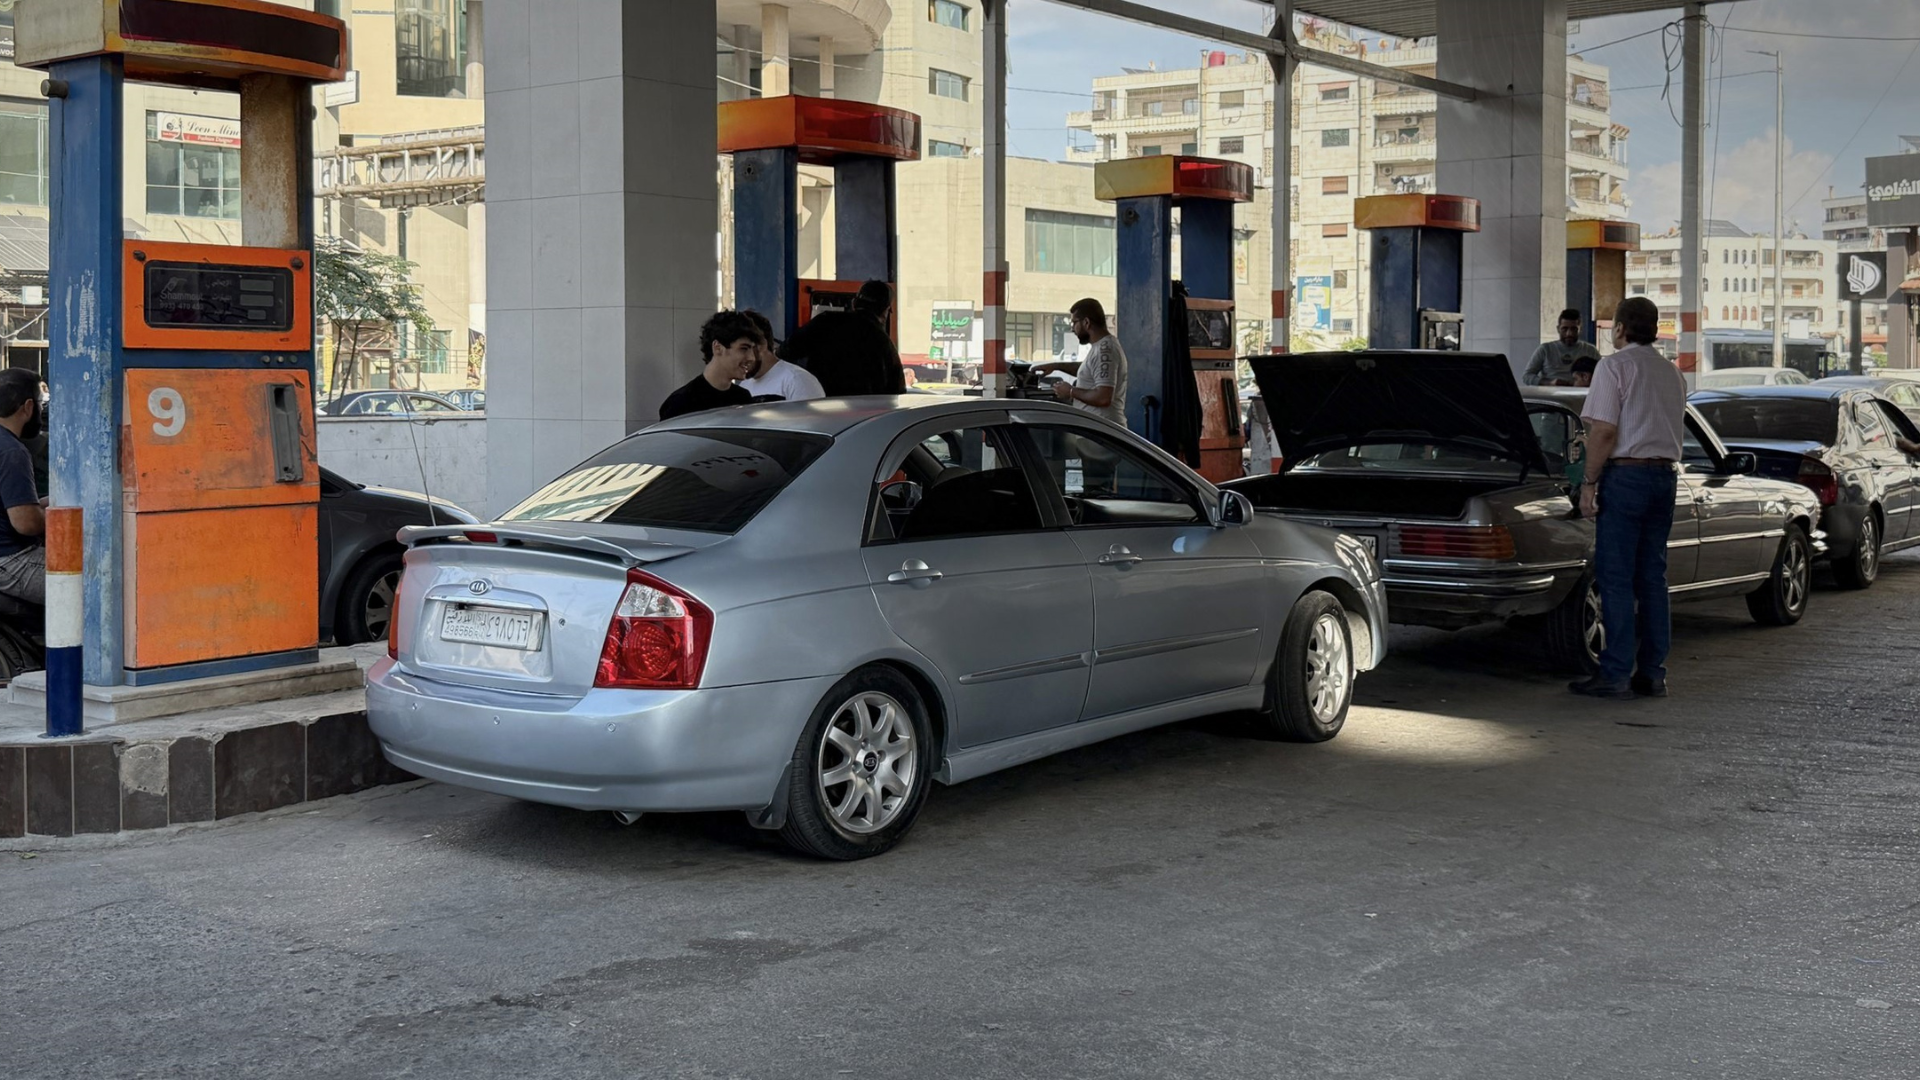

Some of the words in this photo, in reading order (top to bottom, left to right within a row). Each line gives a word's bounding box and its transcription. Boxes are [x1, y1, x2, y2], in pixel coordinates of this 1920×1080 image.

[160, 291, 203, 301] Shammout
[932, 310, 970, 330] صيدلية
[148, 387, 186, 437] 9
[470, 582, 486, 592] KIA
